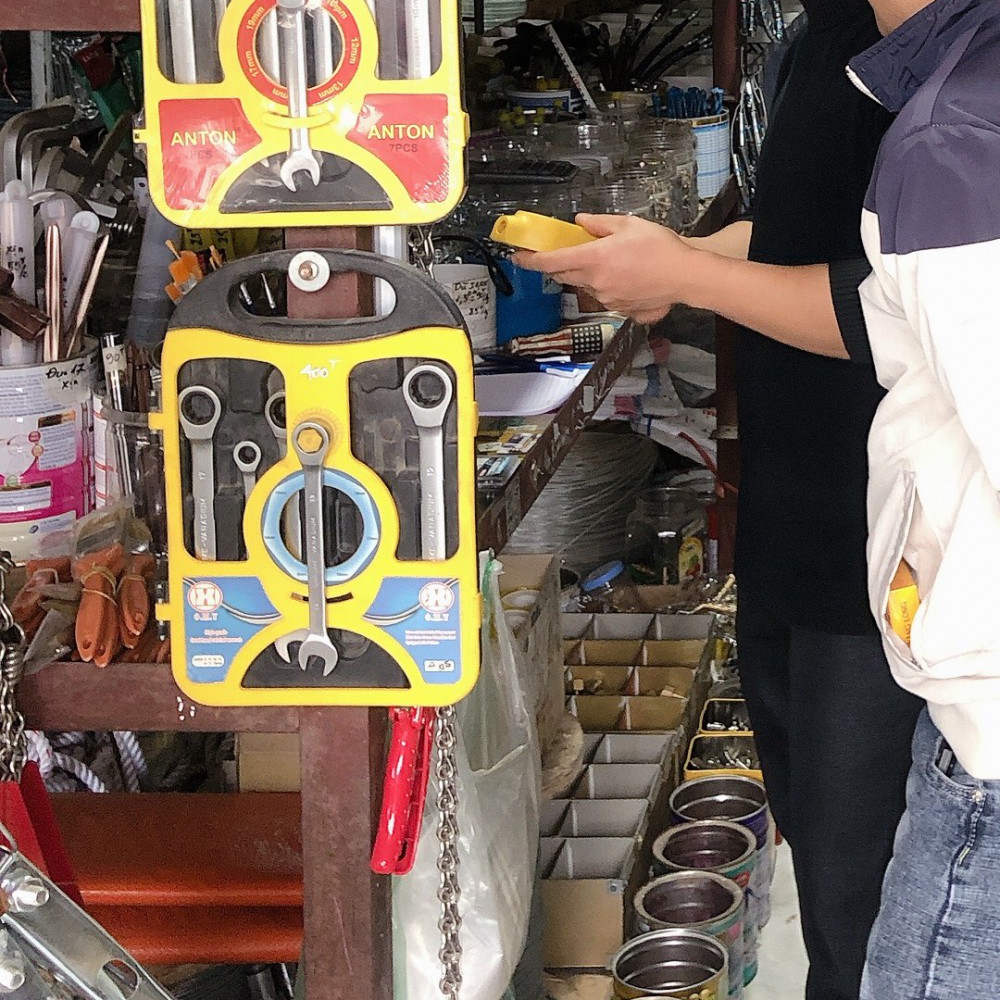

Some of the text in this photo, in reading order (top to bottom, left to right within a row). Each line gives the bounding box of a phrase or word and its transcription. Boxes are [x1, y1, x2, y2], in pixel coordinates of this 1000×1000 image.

[246, 6, 265, 30] 19mm
[350, 37, 360, 65] 12mm
[245, 50, 259, 78] 17mm
[272, 87, 289, 99] mm
[318, 81, 344, 98] 13mm
[170, 130, 237, 147] ANTON
[366, 124, 435, 140] ANTON
[388, 143, 418, 154] 7PCS
[199, 471, 206, 480] 17
